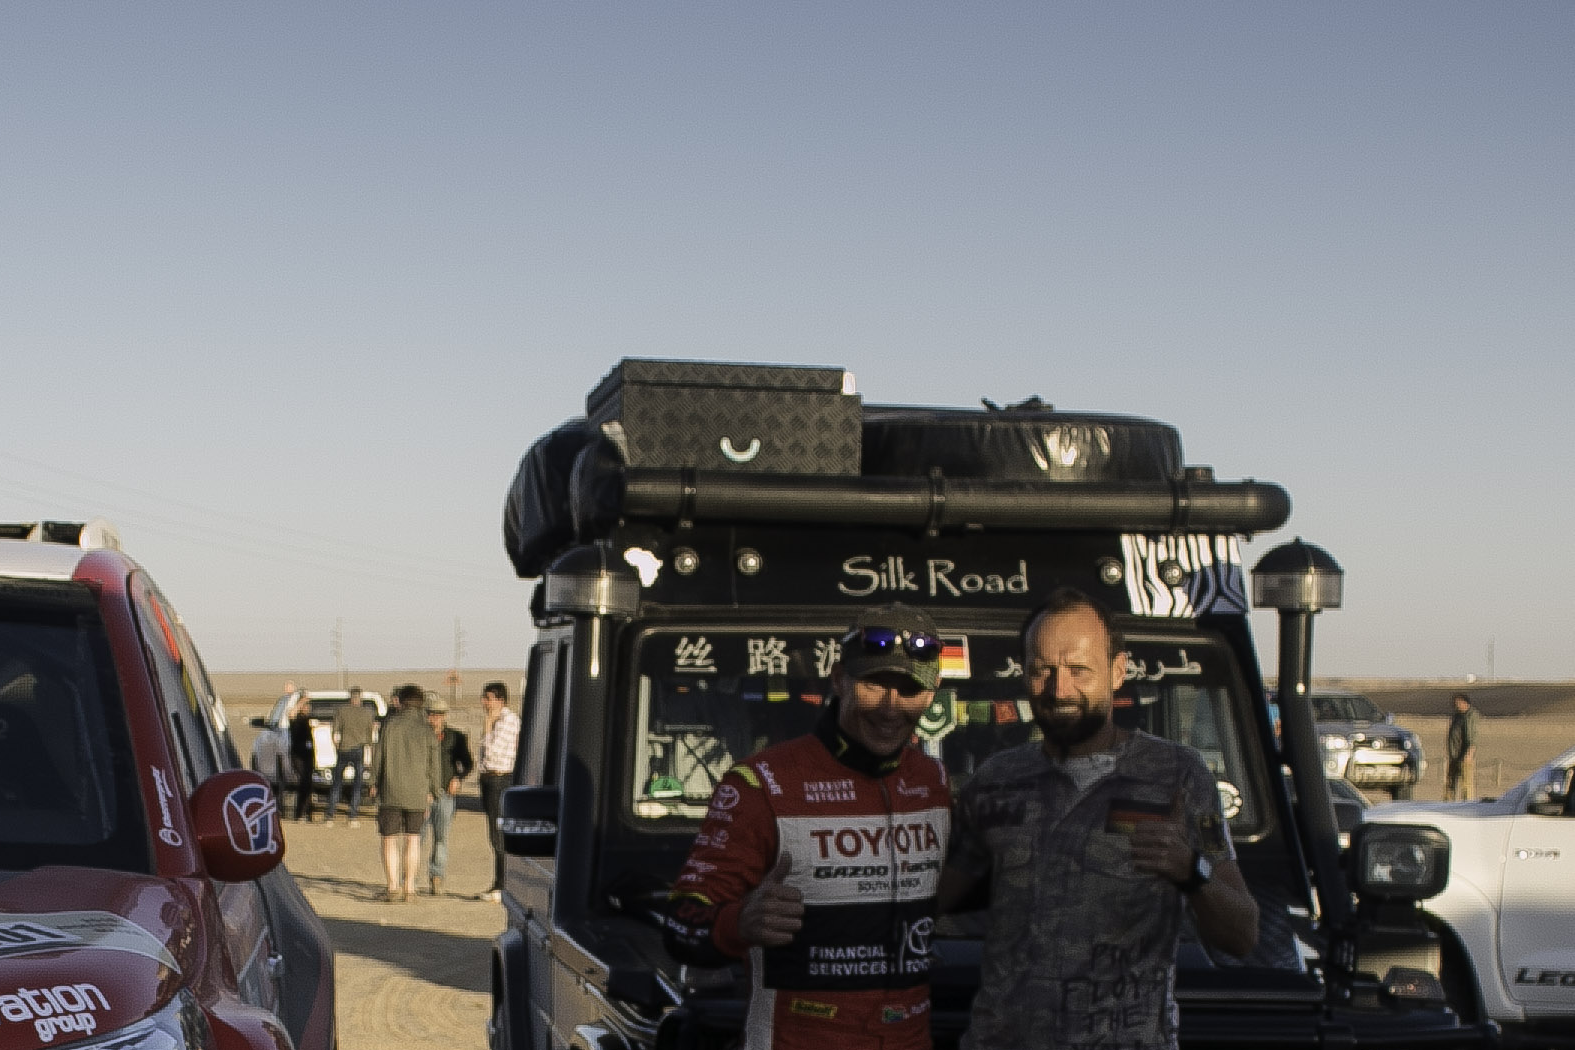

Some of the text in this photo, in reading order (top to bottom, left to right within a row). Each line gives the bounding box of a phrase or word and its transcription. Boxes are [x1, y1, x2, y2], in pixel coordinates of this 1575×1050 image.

[837, 555, 1030, 597] Silk Road
[809, 822, 941, 859] TOYOTA
[812, 865, 889, 879] GAZOO
[808, 945, 888, 960] FINANCIAL
[808, 960, 889, 976] SERVICES
[35, 1013, 98, 1043] group
